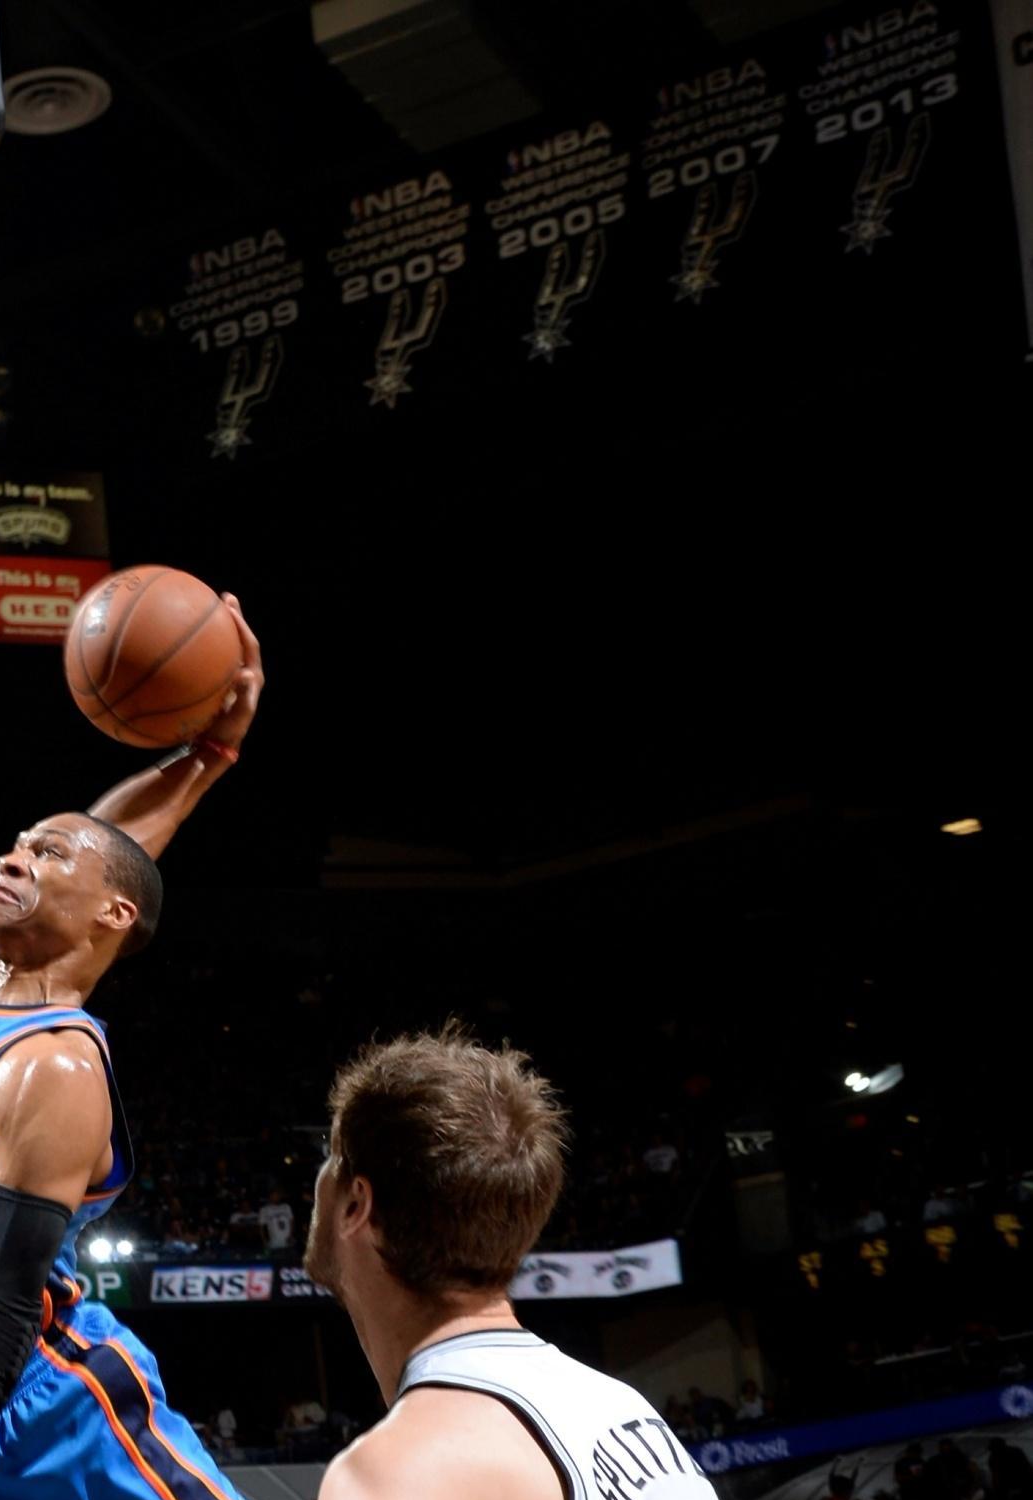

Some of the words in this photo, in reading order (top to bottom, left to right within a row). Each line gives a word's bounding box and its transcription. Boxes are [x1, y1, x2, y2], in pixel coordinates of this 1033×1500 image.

[817, 20, 938, 77] WESTERN
[841, 0, 938, 49] NBA
[673, 57, 766, 107] NBA
[797, 29, 961, 99] CONFERENCE
[805, 49, 958, 115] CHAMPIONS
[638, 92, 787, 151] CONFERENCE
[648, 82, 766, 130] WESTERN
[815, 72, 958, 144] 2013
[500, 142, 612, 191] WESTERN
[522, 119, 613, 168] NBA
[641, 112, 784, 170] CHAMPIONS
[647, 133, 780, 199] 2007
[364, 169, 453, 218] NBA
[484, 152, 630, 214] CONFERENCE
[490, 171, 629, 230] CHAMPIONS
[326, 202, 471, 262] CONFERENCE
[342, 192, 453, 240] WESTERN
[498, 193, 626, 259] 2005
[184, 249, 286, 296] WESTERN
[204, 227, 286, 274] NBA
[332, 221, 468, 278] CHAMPIONS
[341, 241, 466, 305] 2003
[168, 257, 304, 319] CONFERENCE
[176, 276, 305, 331] CHAMPIONS
[190, 298, 300, 354] 1999
[4, 481, 21, 498] is
[23, 484, 47, 509] my
[0, 514, 64, 537] SPURS
[34, 571, 53, 588] is
[54, 575, 81, 601] my
